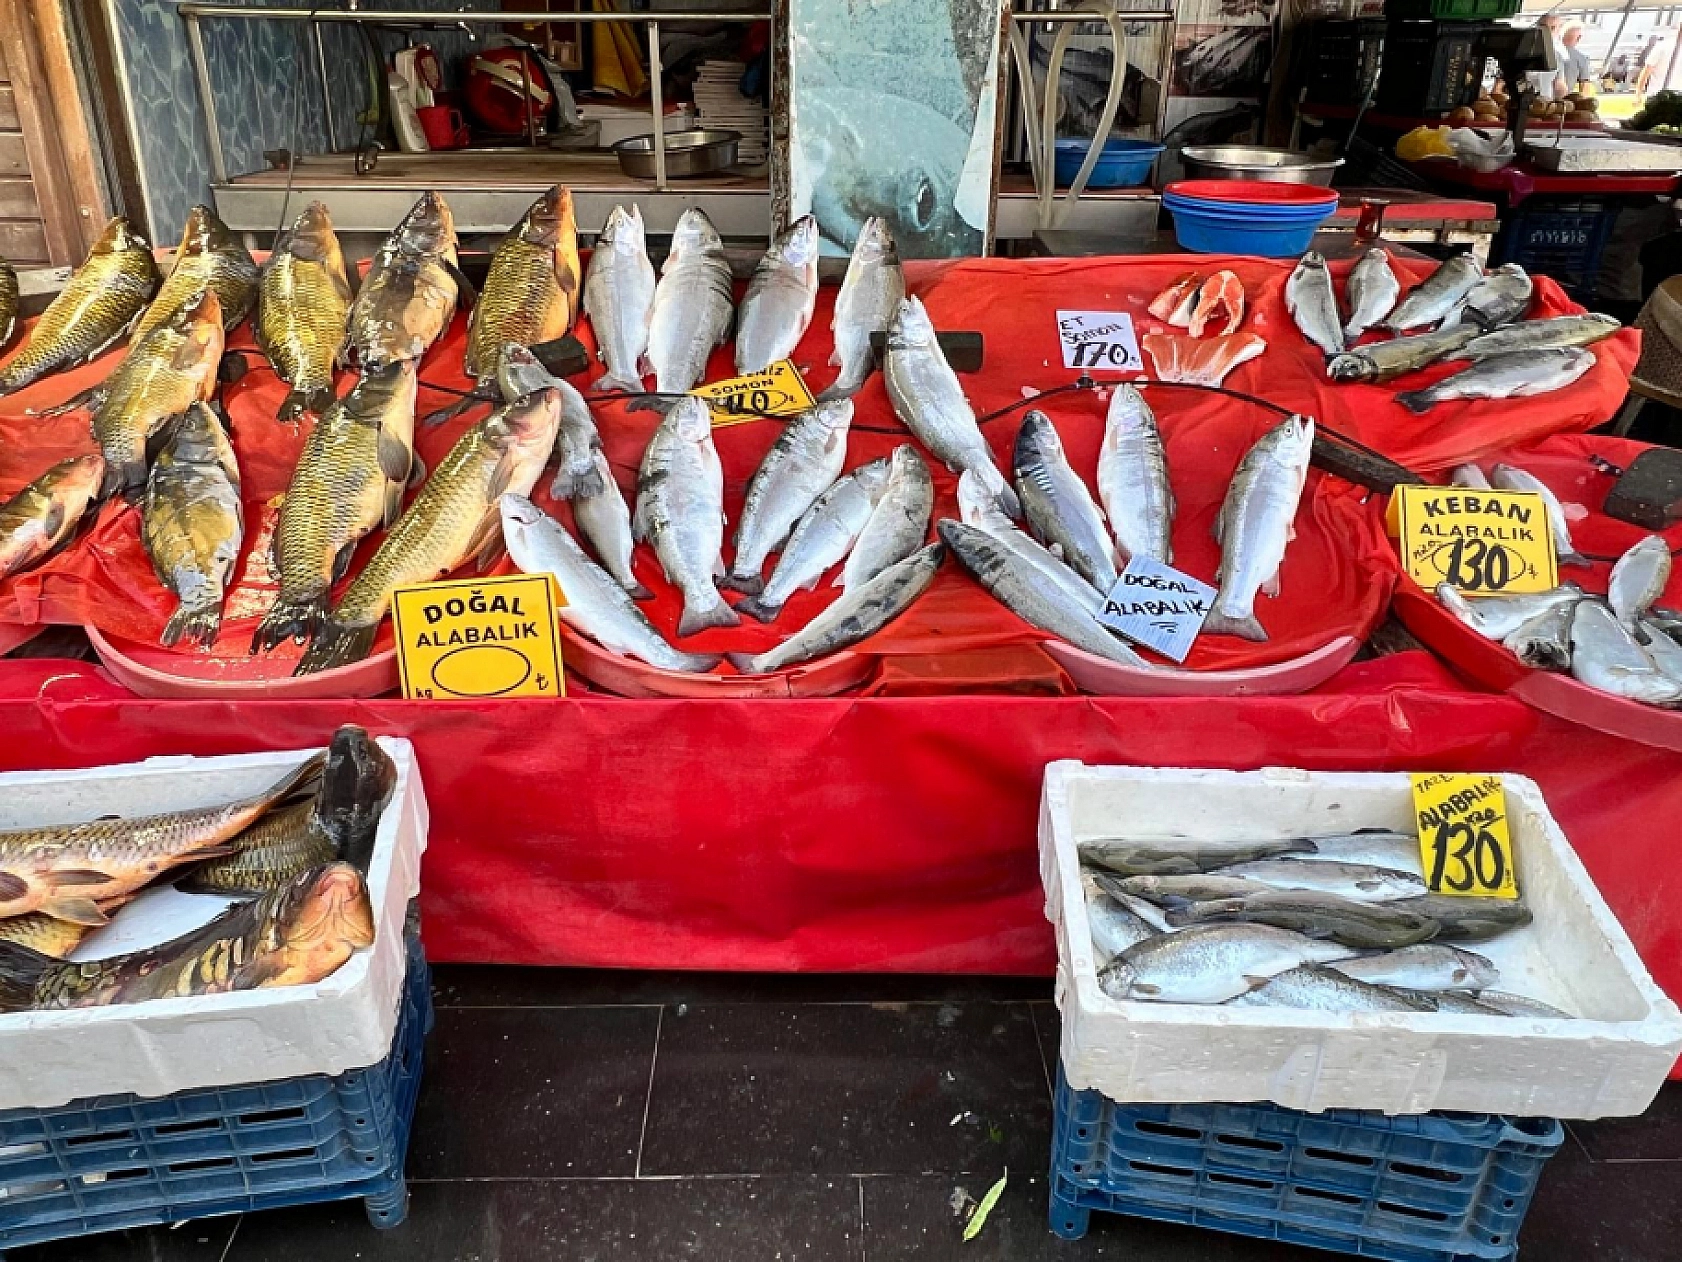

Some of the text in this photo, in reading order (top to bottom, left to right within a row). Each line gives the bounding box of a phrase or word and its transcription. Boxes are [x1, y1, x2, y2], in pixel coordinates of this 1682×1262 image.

[1423, 496, 1532, 525] KEBAN
[1420, 523, 1535, 542] ALABALIK
[1446, 536, 1511, 591] 130
[1124, 573, 1199, 595] DOĞAL
[423, 589, 526, 625] DOĞAL
[416, 621, 540, 649] ALABALIK
[1429, 819, 1505, 891] 130
